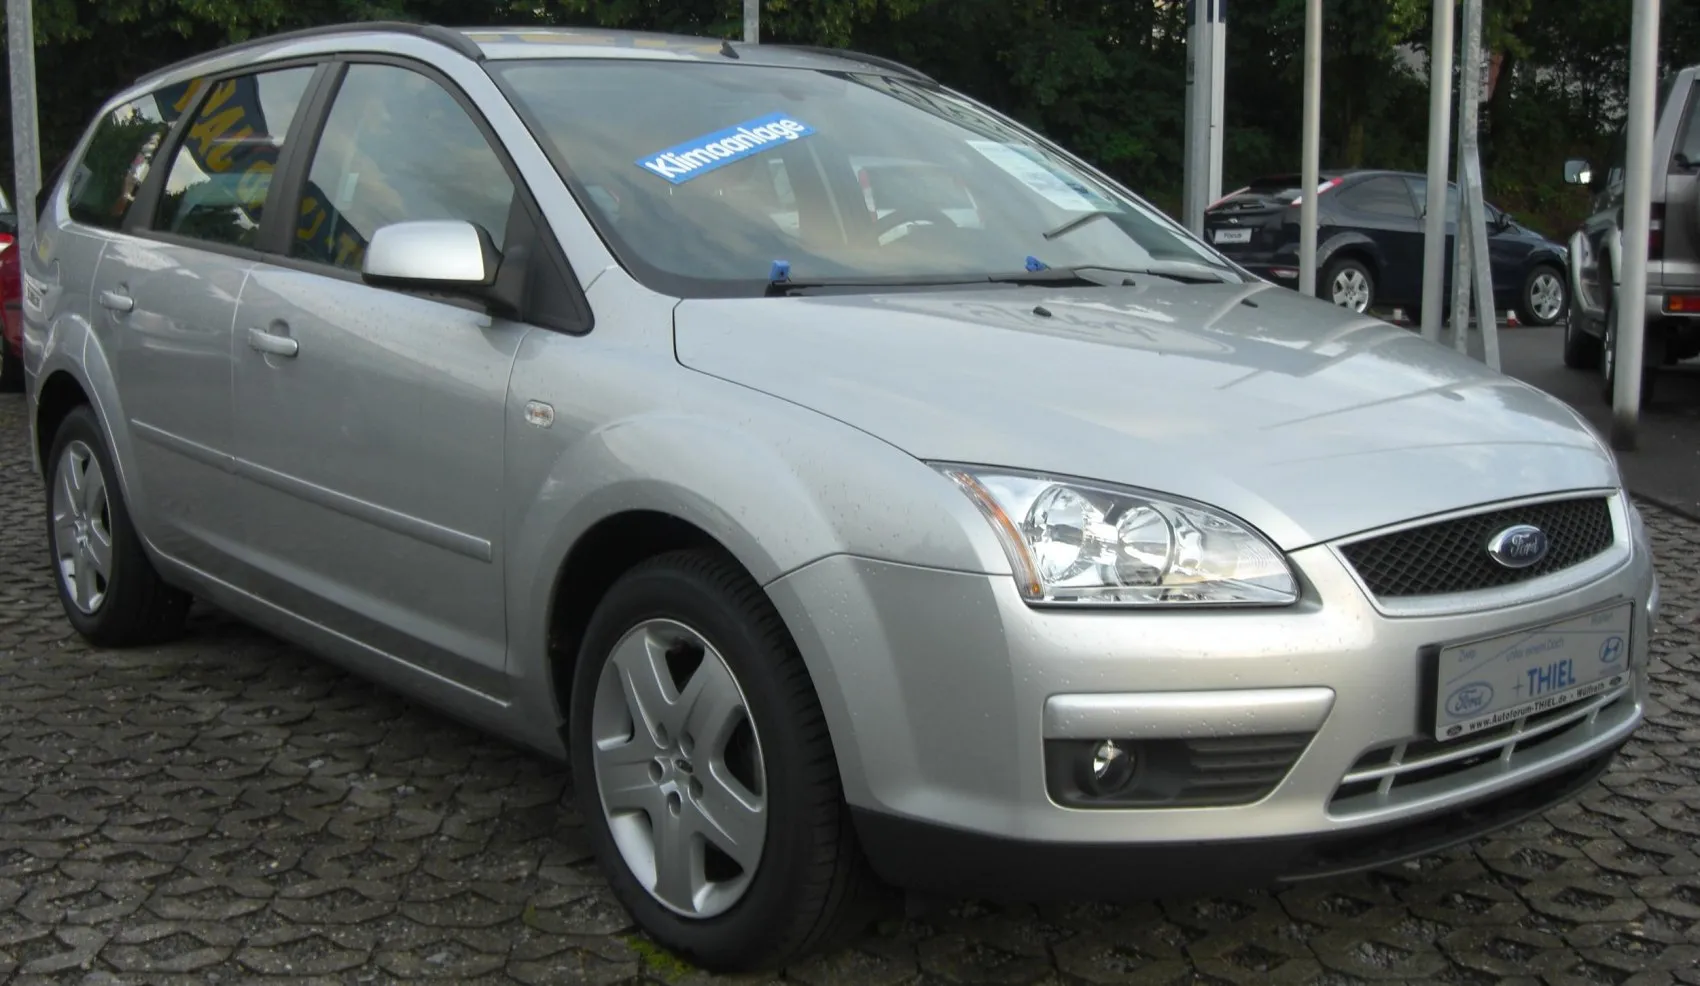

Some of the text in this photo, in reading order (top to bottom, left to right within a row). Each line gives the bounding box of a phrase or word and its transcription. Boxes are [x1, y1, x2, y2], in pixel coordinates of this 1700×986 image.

[645, 118, 804, 178] Klimaanlage
[1511, 534, 1538, 557] Ford
[1527, 658, 1576, 696] THIEL
[1454, 691, 1482, 712] Ford
